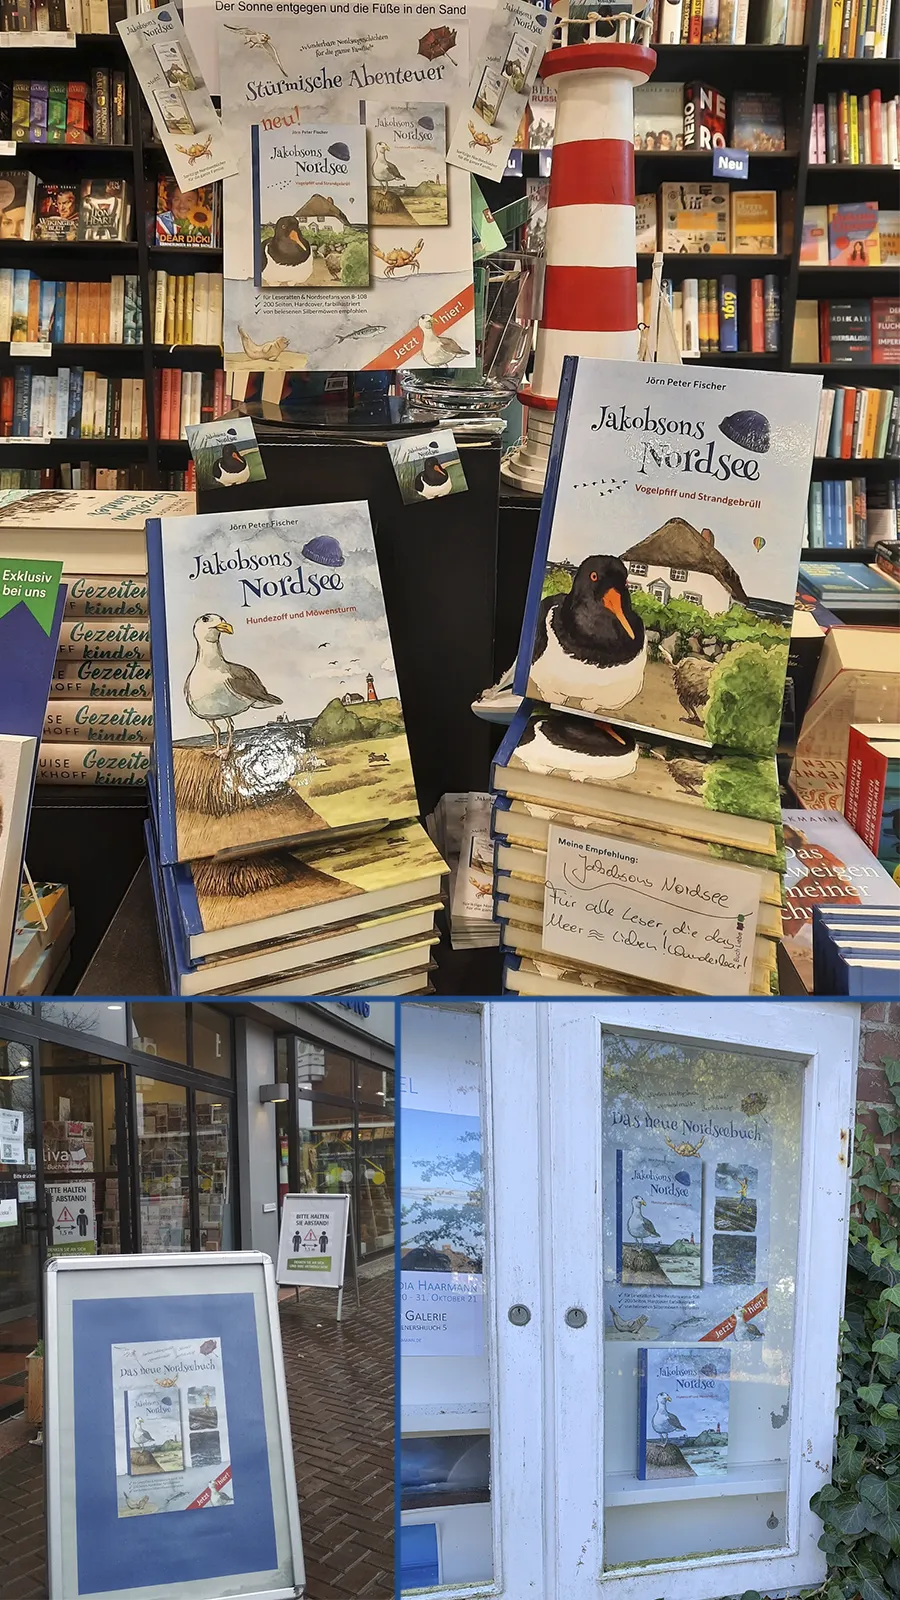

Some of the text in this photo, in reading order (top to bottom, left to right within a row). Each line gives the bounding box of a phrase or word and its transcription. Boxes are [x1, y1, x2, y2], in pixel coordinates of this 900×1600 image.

[215, 1, 467, 15] Der Sonne entgegen und die Füße in den Sand
[246, 63, 444, 102] Stürmische Abenteuer
[700, 87, 726, 119] NE
[261, 105, 300, 132] neu!
[374, 117, 414, 128] Jakobsons
[684, 102, 694, 146] NERO
[394, 128, 434, 142] Nordsee
[700, 125, 726, 150] RO
[270, 144, 322, 160] Jakobsons
[295, 158, 348, 176] Nordsee
[718, 156, 744, 170] Neu
[39, 217, 76, 226] WIKINGER
[86, 216, 114, 226] HEART
[160, 234, 210, 244] DEAR DICKI
[722, 291, 738, 320] 1619
[394, 301, 465, 360] Jetzt hier!
[646, 376, 726, 391] Jörn Peter Fischer
[590, 405, 706, 440] Jakobsons
[637, 441, 761, 482] Nordsee
[635, 484, 762, 510] Vogelpfiff und Strandgebrüll
[229, 518, 298, 531] Jörn Peter Fischer
[189, 548, 293, 580] Jakobsons
[2, 570, 52, 584] Exklusiv
[238, 566, 344, 608] Nordsee
[2, 585, 46, 598] bei uns
[71, 578, 148, 599] Gezeiten
[84, 601, 147, 615] kinder
[246, 606, 357, 624] Hundezoff und Möwensturm
[70, 622, 150, 642] Gezeiten
[83, 645, 144, 660] kinder
[78, 660, 152, 680] Gezeiten
[90, 683, 150, 698] kinder
[75, 705, 154, 726] Gezeiten
[88, 728, 148, 742] kinder
[36, 771, 87, 779] KHOFF
[848, 760, 858, 810] UNENDLICH
[854, 759, 863, 800] SOMMER
[865, 779, 874, 832] UNENDLICH
[872, 779, 880, 821] SOMMER
[558, 838, 639, 864] Meine Empfehlung:
[572, 854, 730, 908] Jakobsons Nordsee
[785, 882, 872, 898] meiner
[544, 880, 734, 950] Für alle Leser, die das
[546, 913, 584, 934] Meer
[612, 1112, 762, 1141] Das neue Nordseebuch
[631, 1170, 672, 1183] Jakobsons
[650, 1184, 690, 1198] Nordsee
[405, 1310, 448, 1322] GALERIE
[715, 1298, 765, 1339] Jetzt hier!
[120, 1358, 216, 1378] Das neue Nordseebuch
[656, 1366, 698, 1378] Jakobsons
[676, 1380, 716, 1392] Nordsee
[196, 1472, 230, 1507] Jetzt hier!
